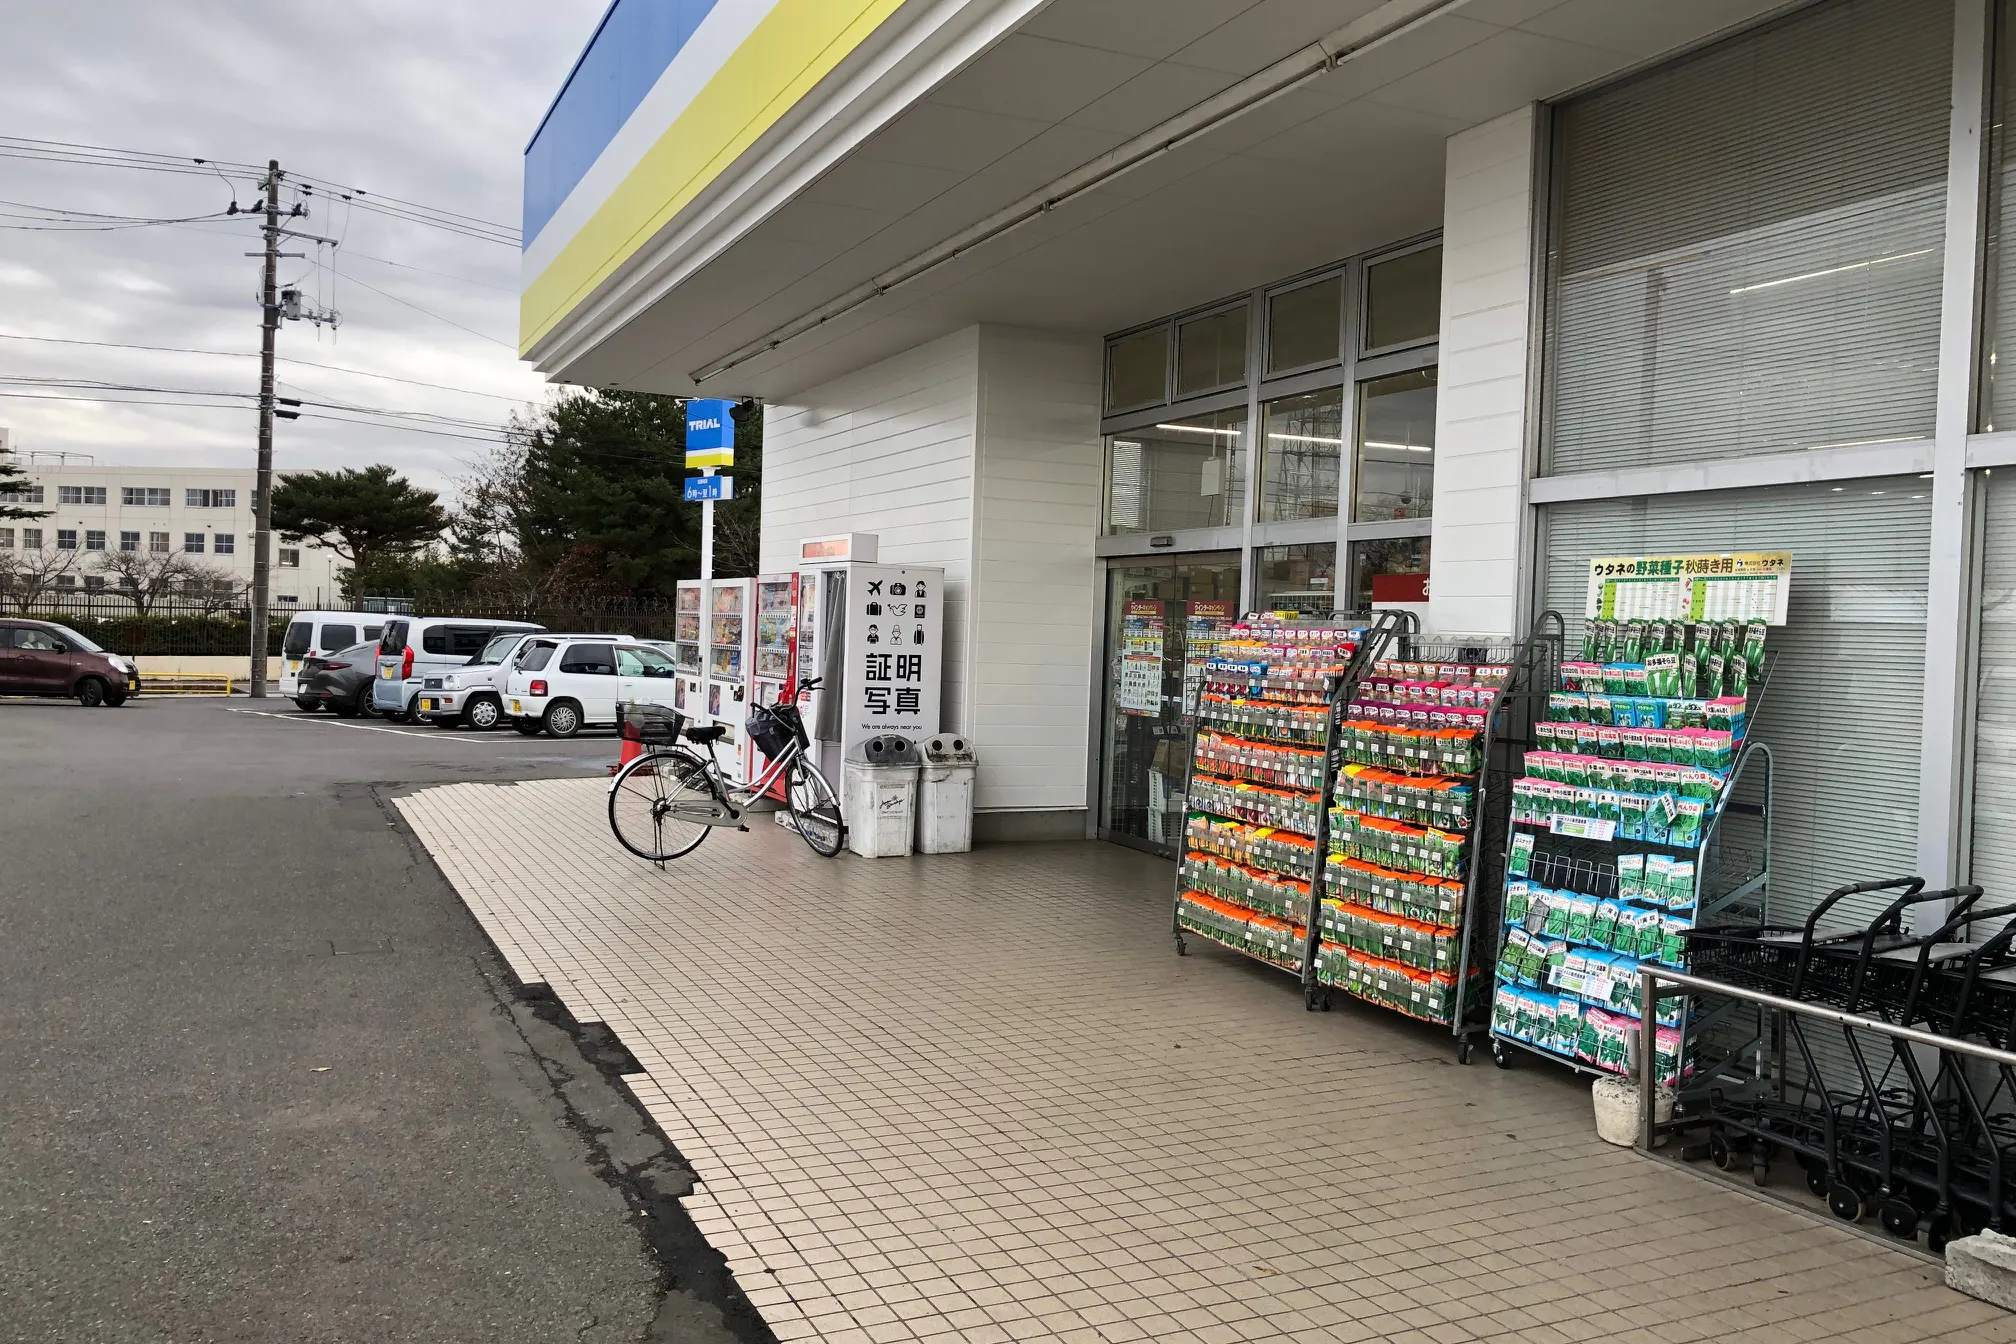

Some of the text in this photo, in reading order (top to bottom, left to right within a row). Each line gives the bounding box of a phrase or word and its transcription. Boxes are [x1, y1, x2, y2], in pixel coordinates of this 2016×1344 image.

[689, 418, 720, 431] TRIAL
[865, 652, 922, 682] 証明
[864, 686, 922, 715] 写真
[882, 723, 899, 731] always
